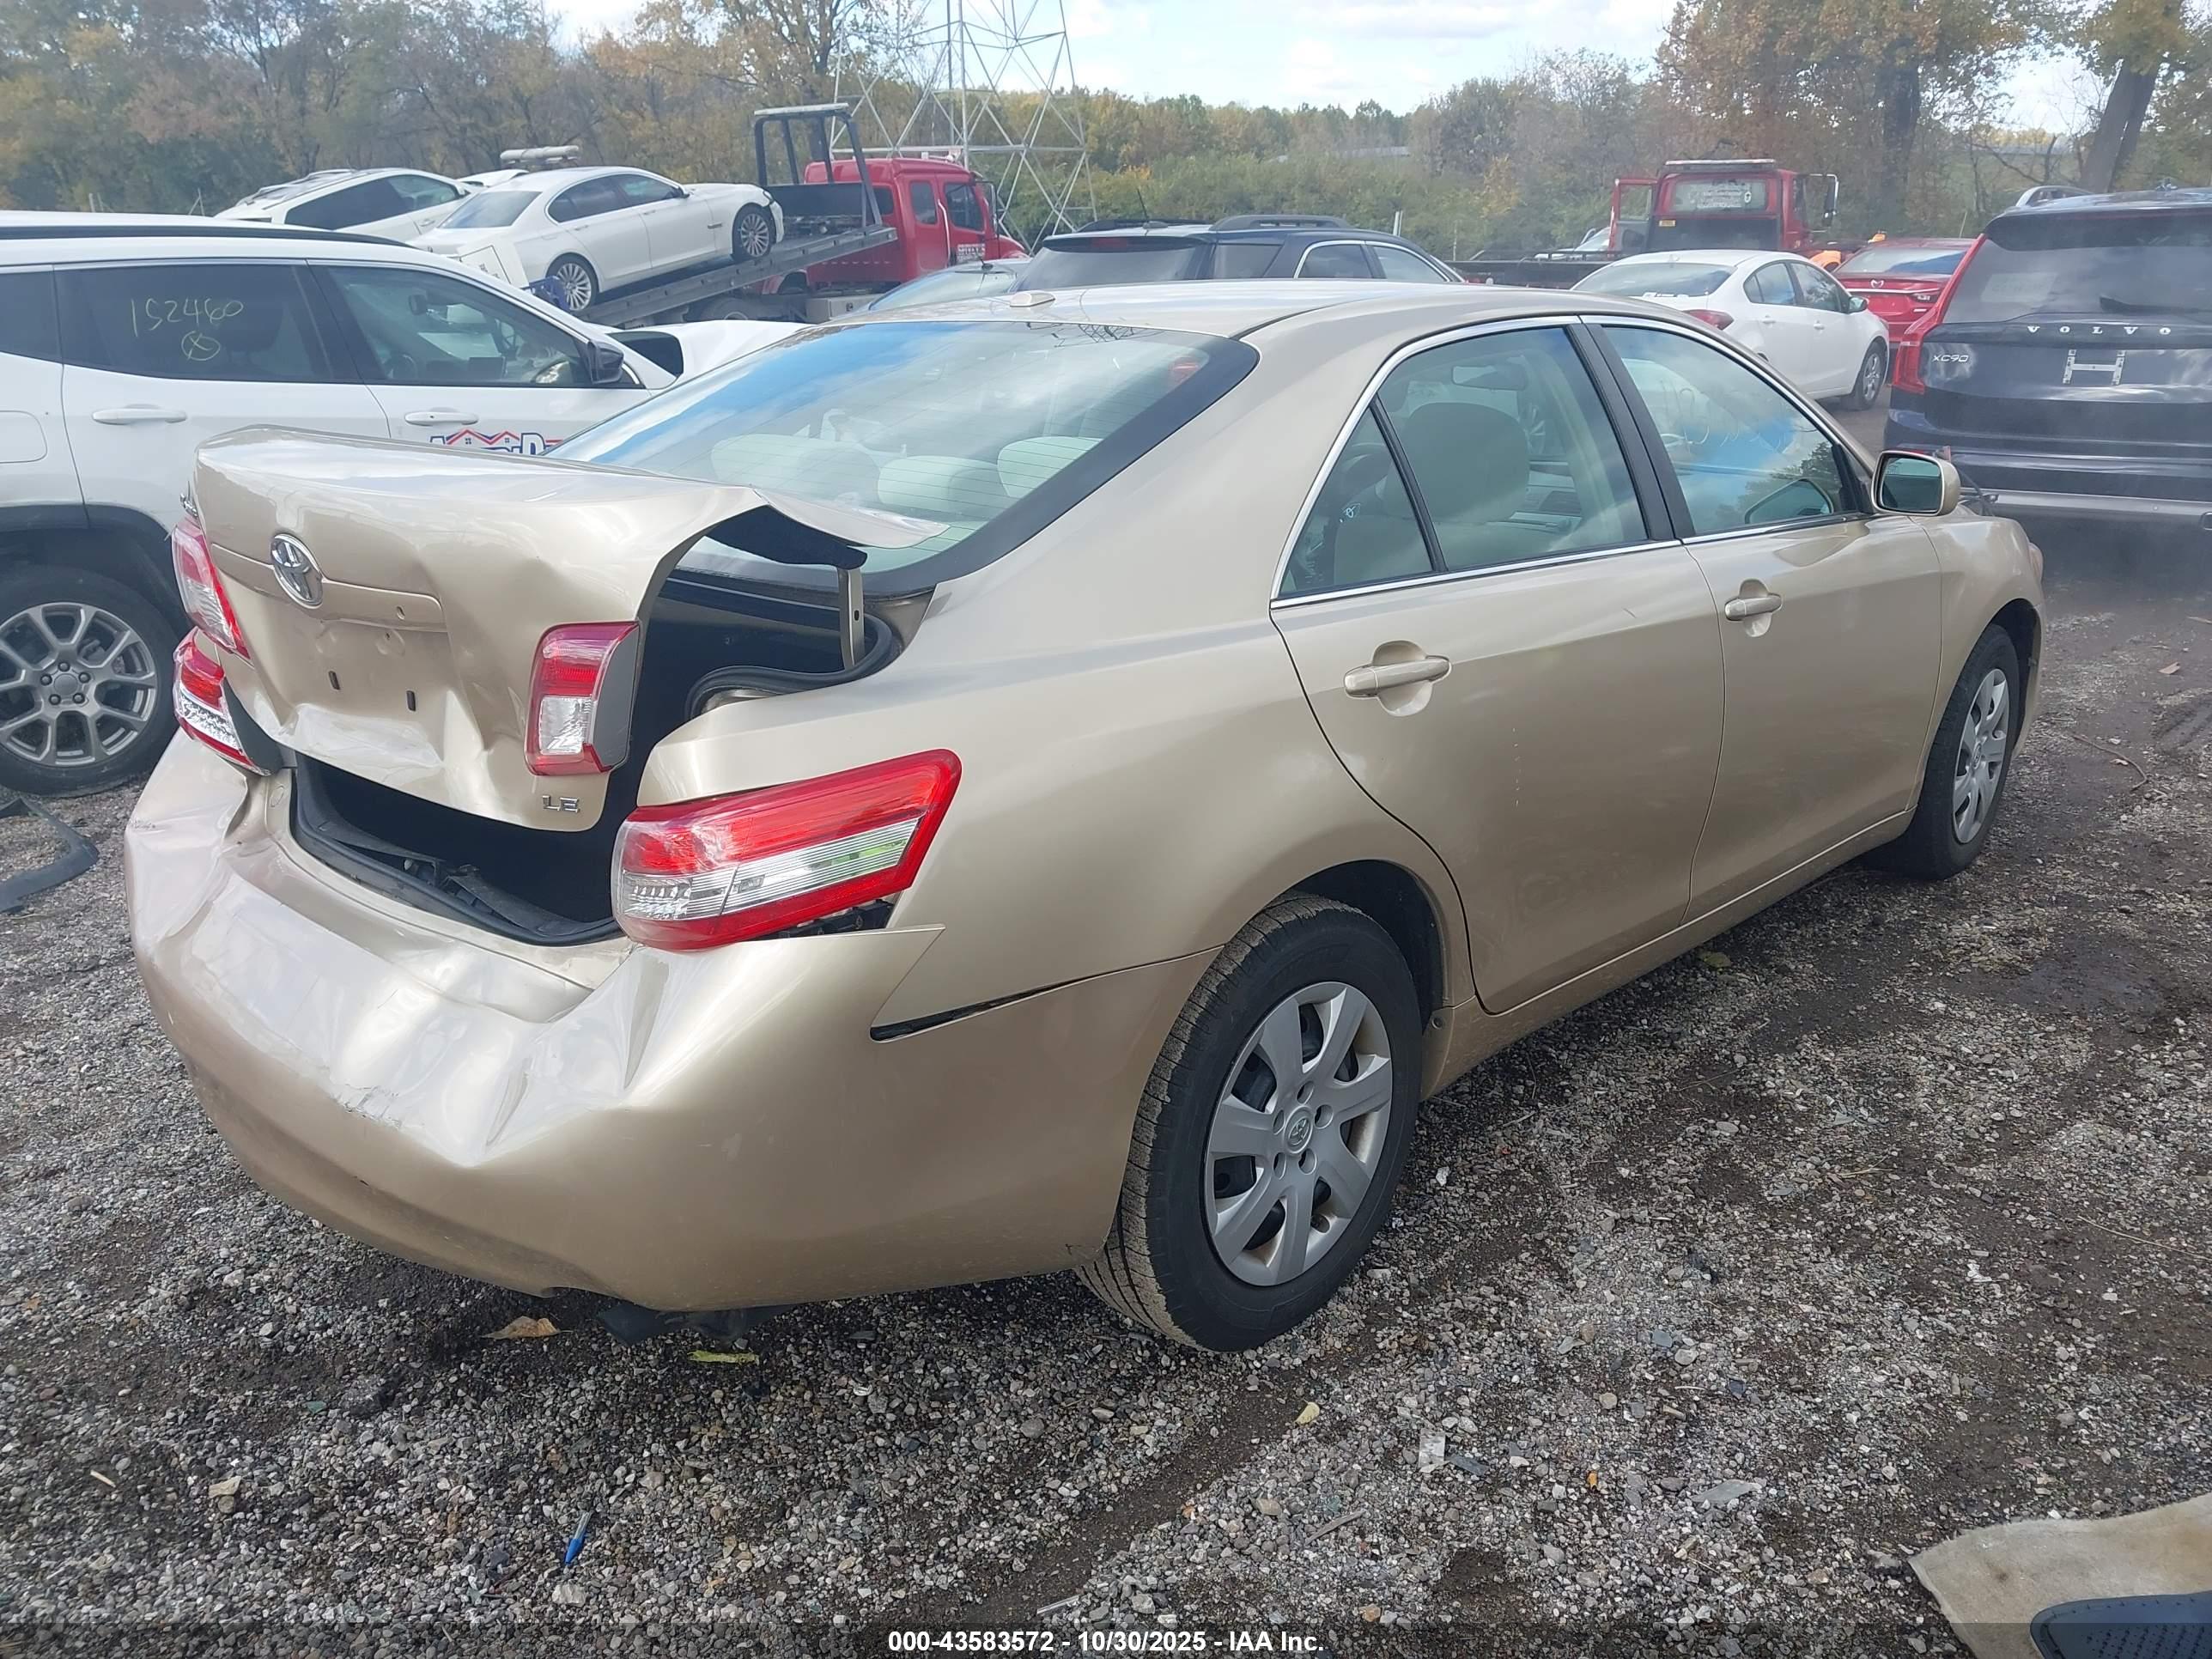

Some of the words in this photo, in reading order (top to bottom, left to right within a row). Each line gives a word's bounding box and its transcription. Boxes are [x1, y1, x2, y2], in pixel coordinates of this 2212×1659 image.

[131, 298, 244, 337] 152460
[2027, 325, 2172, 336] VOLVO
[1932, 354, 1969, 362] XC90
[542, 795, 579, 813] LE
